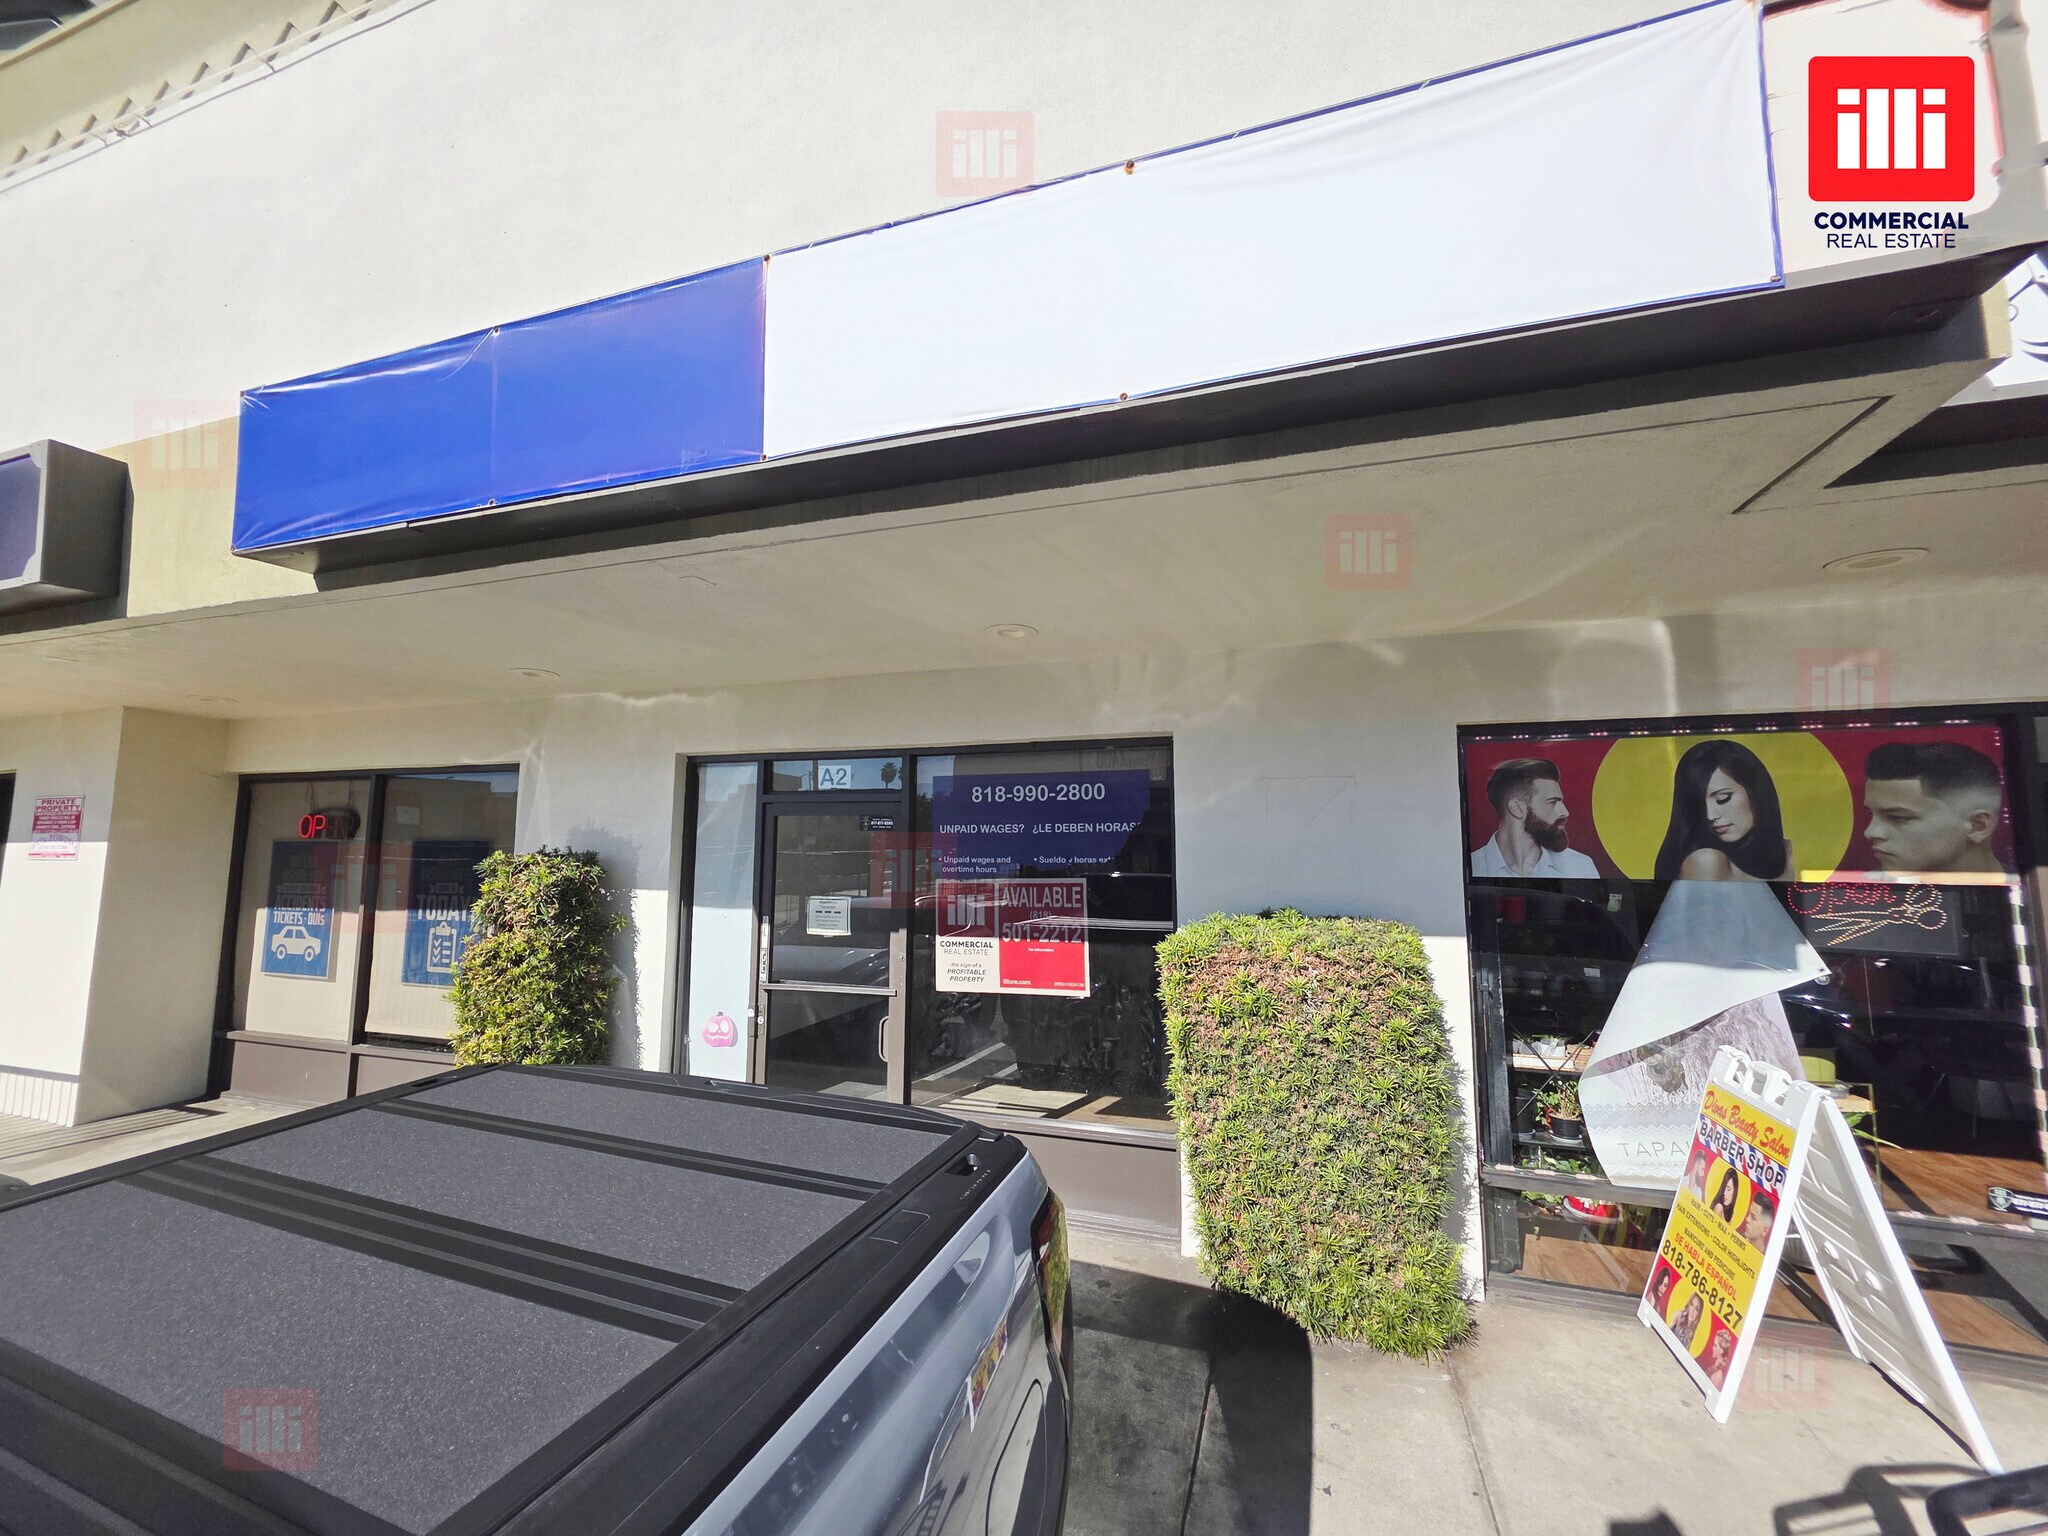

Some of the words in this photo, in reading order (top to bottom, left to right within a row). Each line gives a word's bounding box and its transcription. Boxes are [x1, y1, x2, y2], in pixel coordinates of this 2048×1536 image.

[820, 767, 847, 786] A2
[971, 783, 1106, 803] 818-990-2800
[939, 824, 979, 834] UNPAID
[980, 823, 1025, 834] WAGES?
[1032, 823, 1053, 834] ¿LE
[1055, 823, 1094, 833] DEBEN
[1096, 821, 1142, 832] HORAS
[942, 865, 974, 873] overtime
[976, 865, 997, 873] hours
[943, 856, 970, 865] Unpaid
[971, 857, 995, 865] wages
[996, 856, 1011, 864] and
[1038, 856, 1066, 864] Sueldo
[274, 895, 327, 911] ACCIDENTS
[1001, 886, 1082, 908] AVAILABLE
[273, 911, 303, 924] TICKETS
[307, 911, 325, 925] DUIs
[1002, 922, 1082, 943] 501-2212
[940, 941, 993, 949] COMMERCIAL
[947, 968, 987, 976] PROFITABLE
[1703, 1090, 1727, 1121] Divas
[1728, 1104, 1759, 1144] Beauty
[1760, 1126, 1790, 1160] Salon
[1617, 1140, 1690, 1157] TAPA
[1700, 1121, 1745, 1163] BARBER
[1747, 1153, 1783, 1188] SHOP
[1691, 1198, 1701, 1212] HAIR
[1703, 1208, 1715, 1223] CUTS
[1717, 1220, 1728, 1234] WAX
[1730, 1232, 1747, 1251] PERMS
[1674, 1232, 1685, 1246] SE
[1685, 1242, 1705, 1269] HABLA
[1676, 1203, 1686, 1216] HAIR
[1685, 1211, 1710, 1238] EXTENSIONS
[1712, 1235, 1728, 1254] COLOR
[1728, 1249, 1755, 1280] HIGHLIGHTS
[1684, 1227, 1705, 1250] MANICURE
[1704, 1247, 1714, 1260] AND
[1713, 1256, 1736, 1280] PEDICURE
[1662, 1239, 1743, 1329] 818-786-8127
